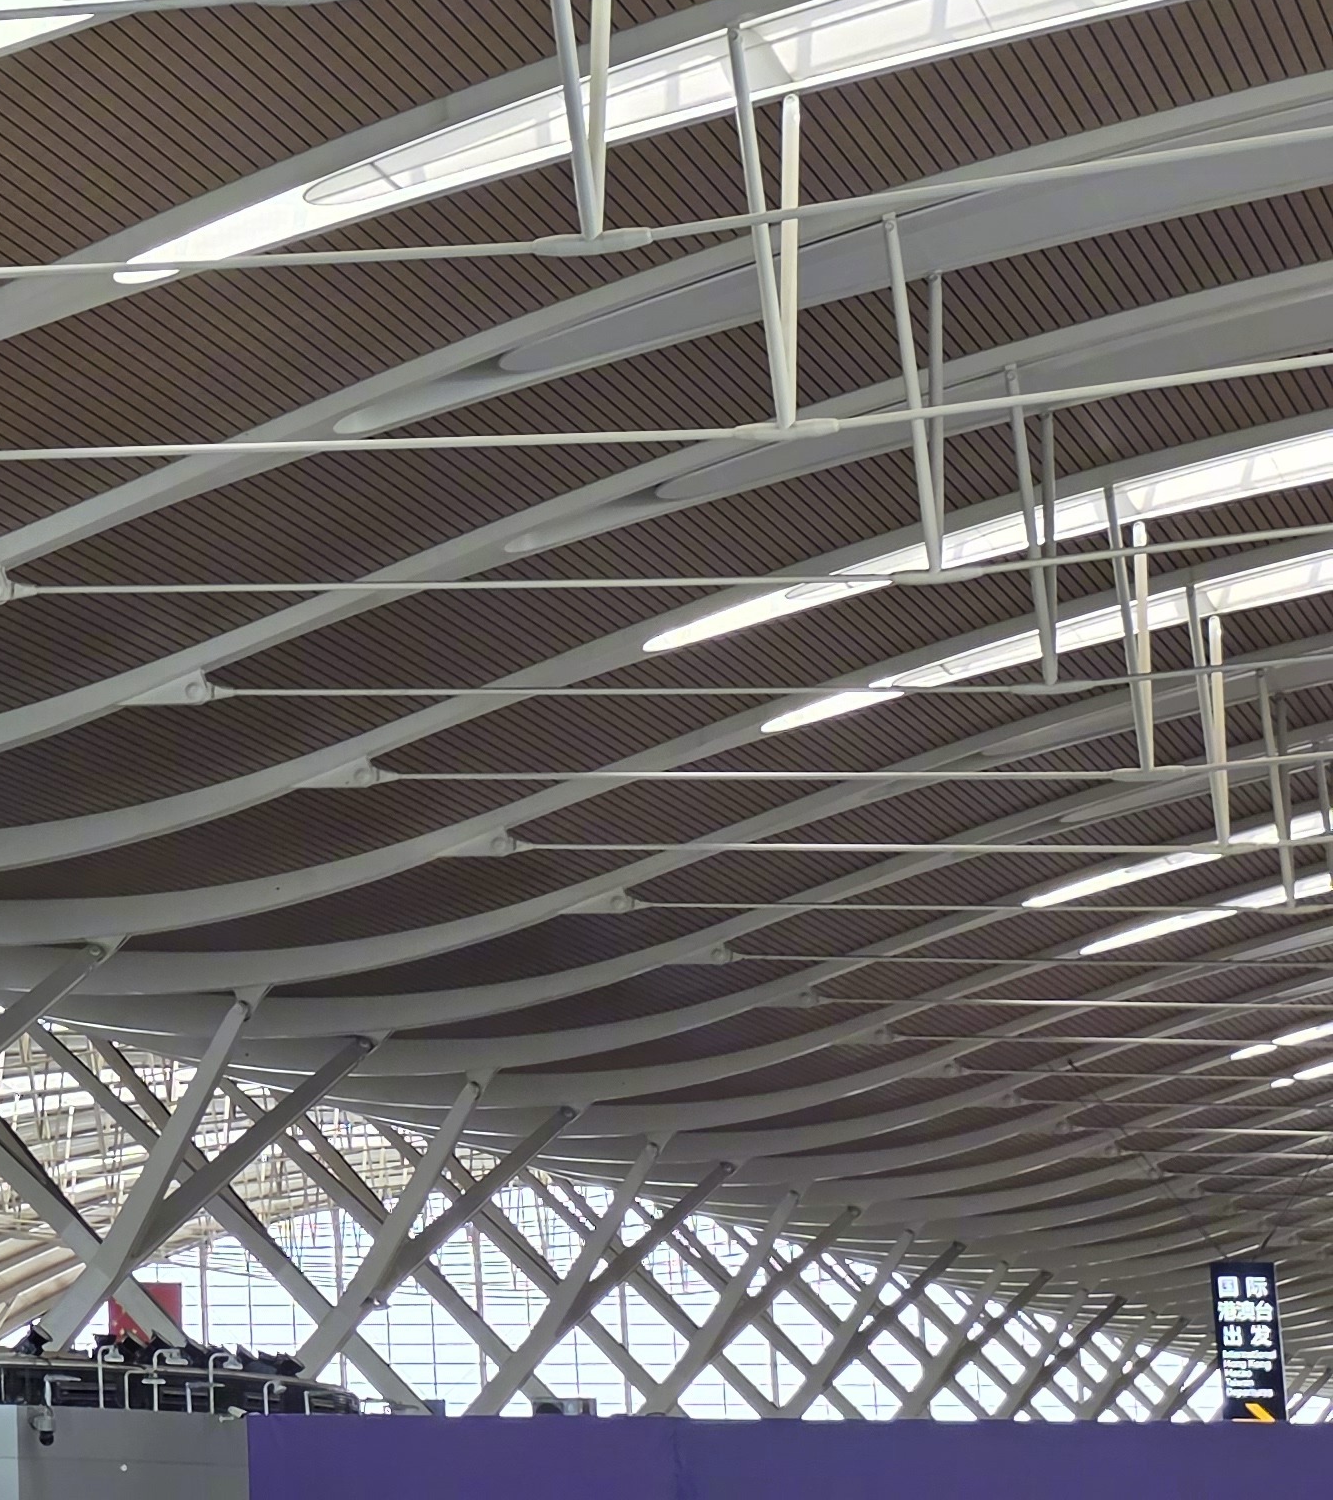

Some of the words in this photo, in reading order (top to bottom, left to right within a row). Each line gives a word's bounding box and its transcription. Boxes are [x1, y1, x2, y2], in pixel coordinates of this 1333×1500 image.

[1217, 1275, 1268, 1299] 国际
[1217, 1300, 1273, 1322] 港澳台
[1222, 1324, 1273, 1347] 出发
